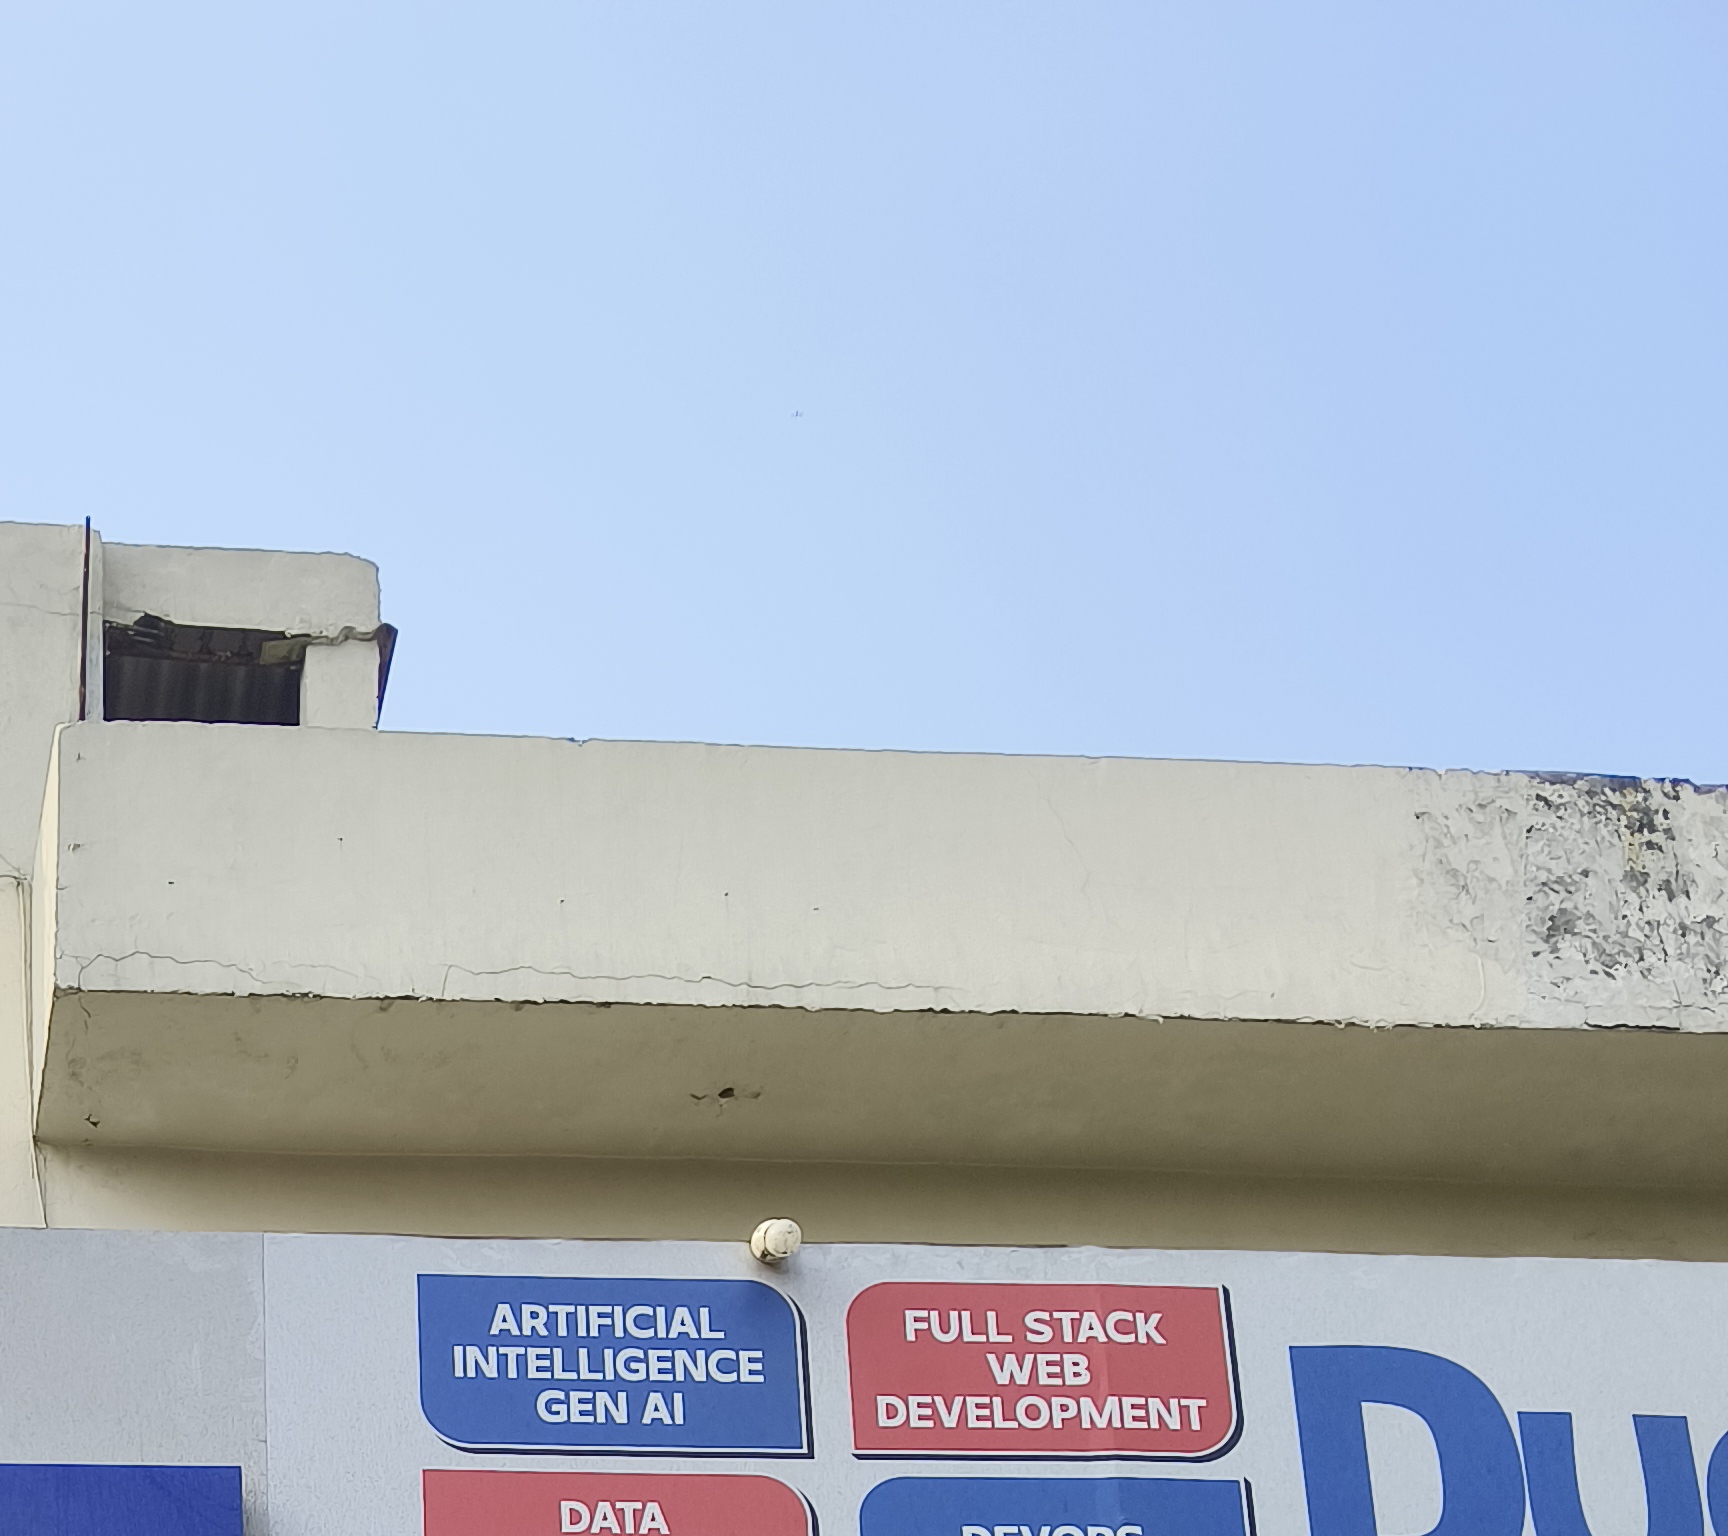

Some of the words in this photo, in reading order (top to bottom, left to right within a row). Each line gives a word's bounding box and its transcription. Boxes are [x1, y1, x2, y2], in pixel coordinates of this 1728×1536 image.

[489, 1303, 725, 1340] ARTIFICIAL
[903, 1309, 1013, 1343] FULL
[1023, 1310, 1168, 1345] STACK
[453, 1345, 766, 1385] INTELLIGENCE
[985, 1352, 1091, 1387] WEB
[535, 1389, 628, 1424] GEN
[641, 1391, 685, 1425] AI
[876, 1394, 1208, 1431] DEVELOPMENT
[560, 1500, 670, 1535] DATA
